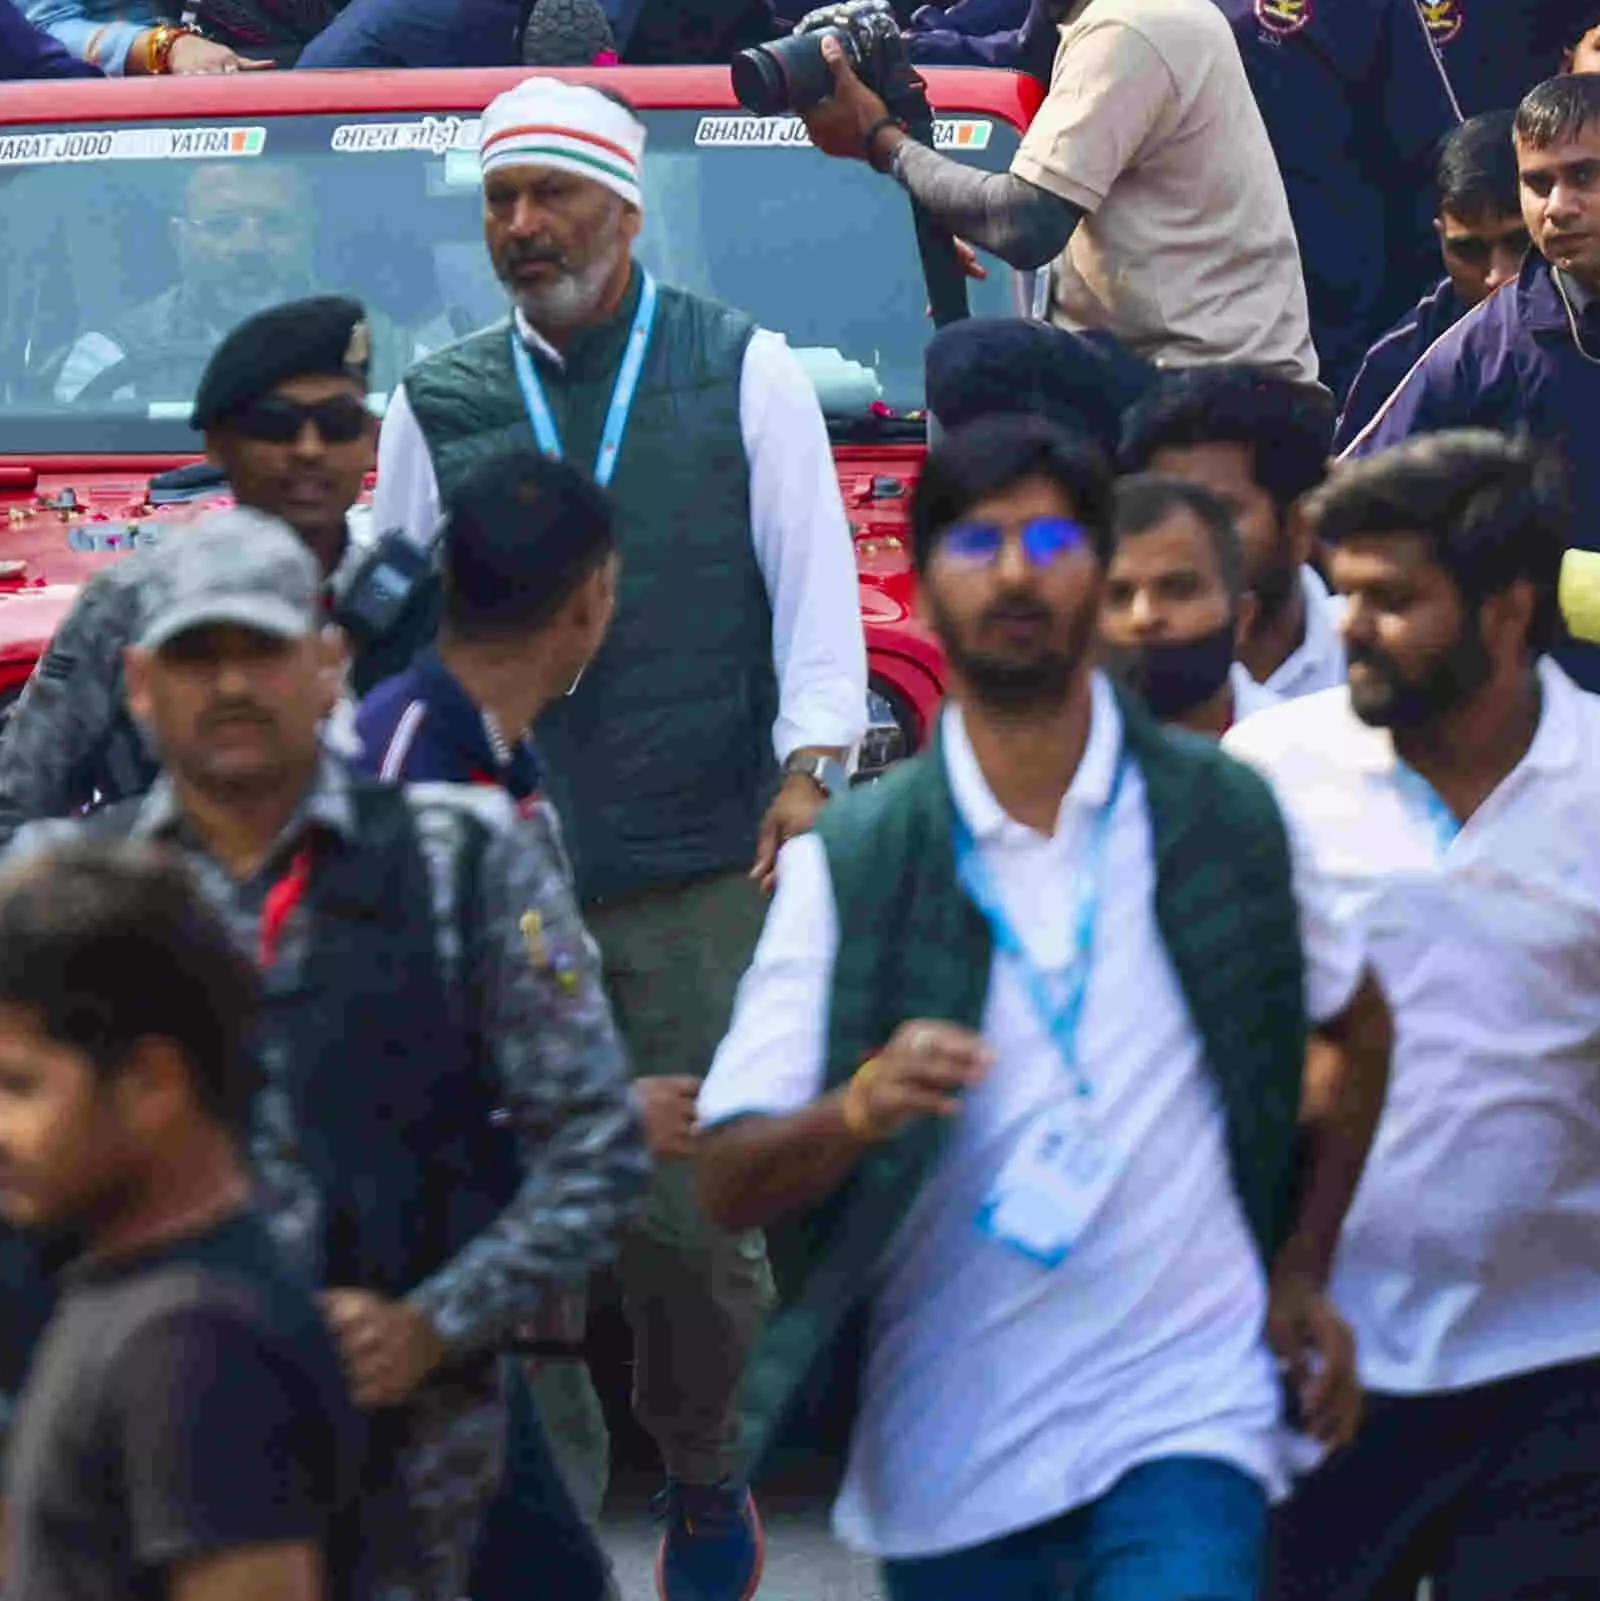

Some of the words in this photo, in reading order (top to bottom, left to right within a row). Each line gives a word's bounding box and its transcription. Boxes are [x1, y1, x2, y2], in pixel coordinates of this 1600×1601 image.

[54, 135, 113, 157] JODO
[171, 131, 229, 151] YATRA
[335, 126, 399, 147] भारत
[407, 120, 461, 151] जोड़ो
[699, 121, 776, 142] BHARAT
[778, 121, 813, 142] JO
